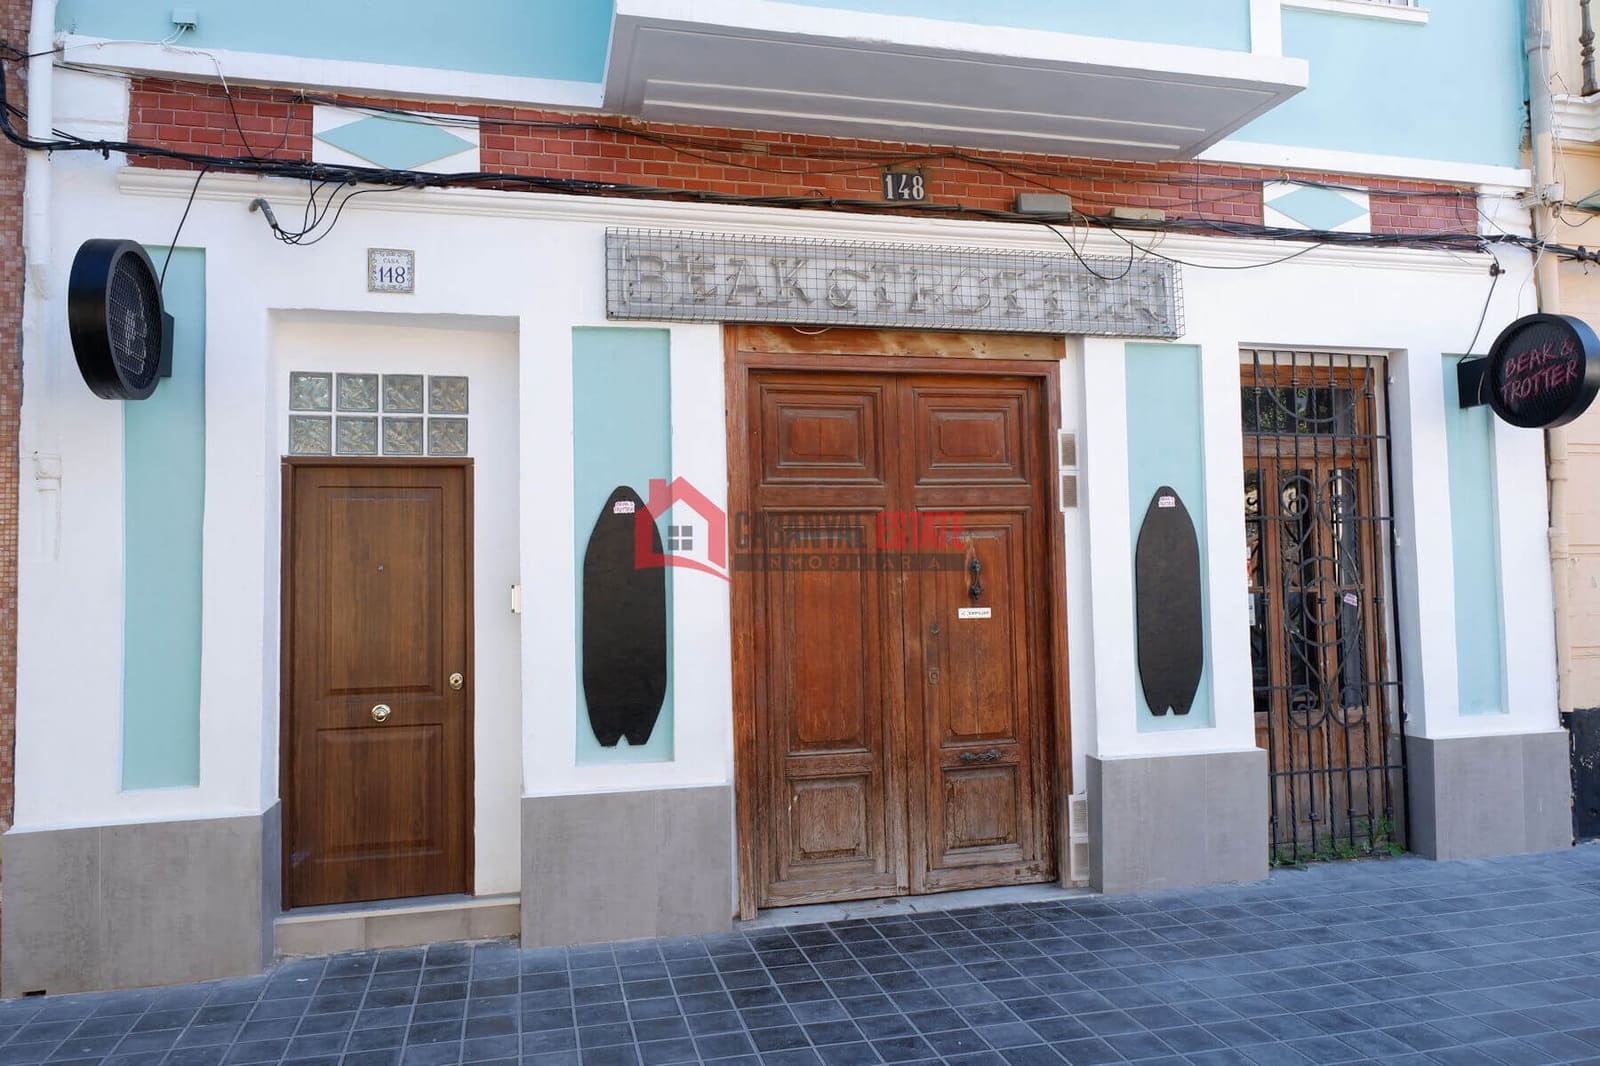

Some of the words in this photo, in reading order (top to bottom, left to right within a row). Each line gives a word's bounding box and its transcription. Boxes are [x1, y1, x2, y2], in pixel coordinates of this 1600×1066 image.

[885, 174, 925, 200] 148
[380, 266, 406, 284] 148
[1505, 341, 1557, 378] BEAK
[1500, 360, 1578, 408] TROTTER
